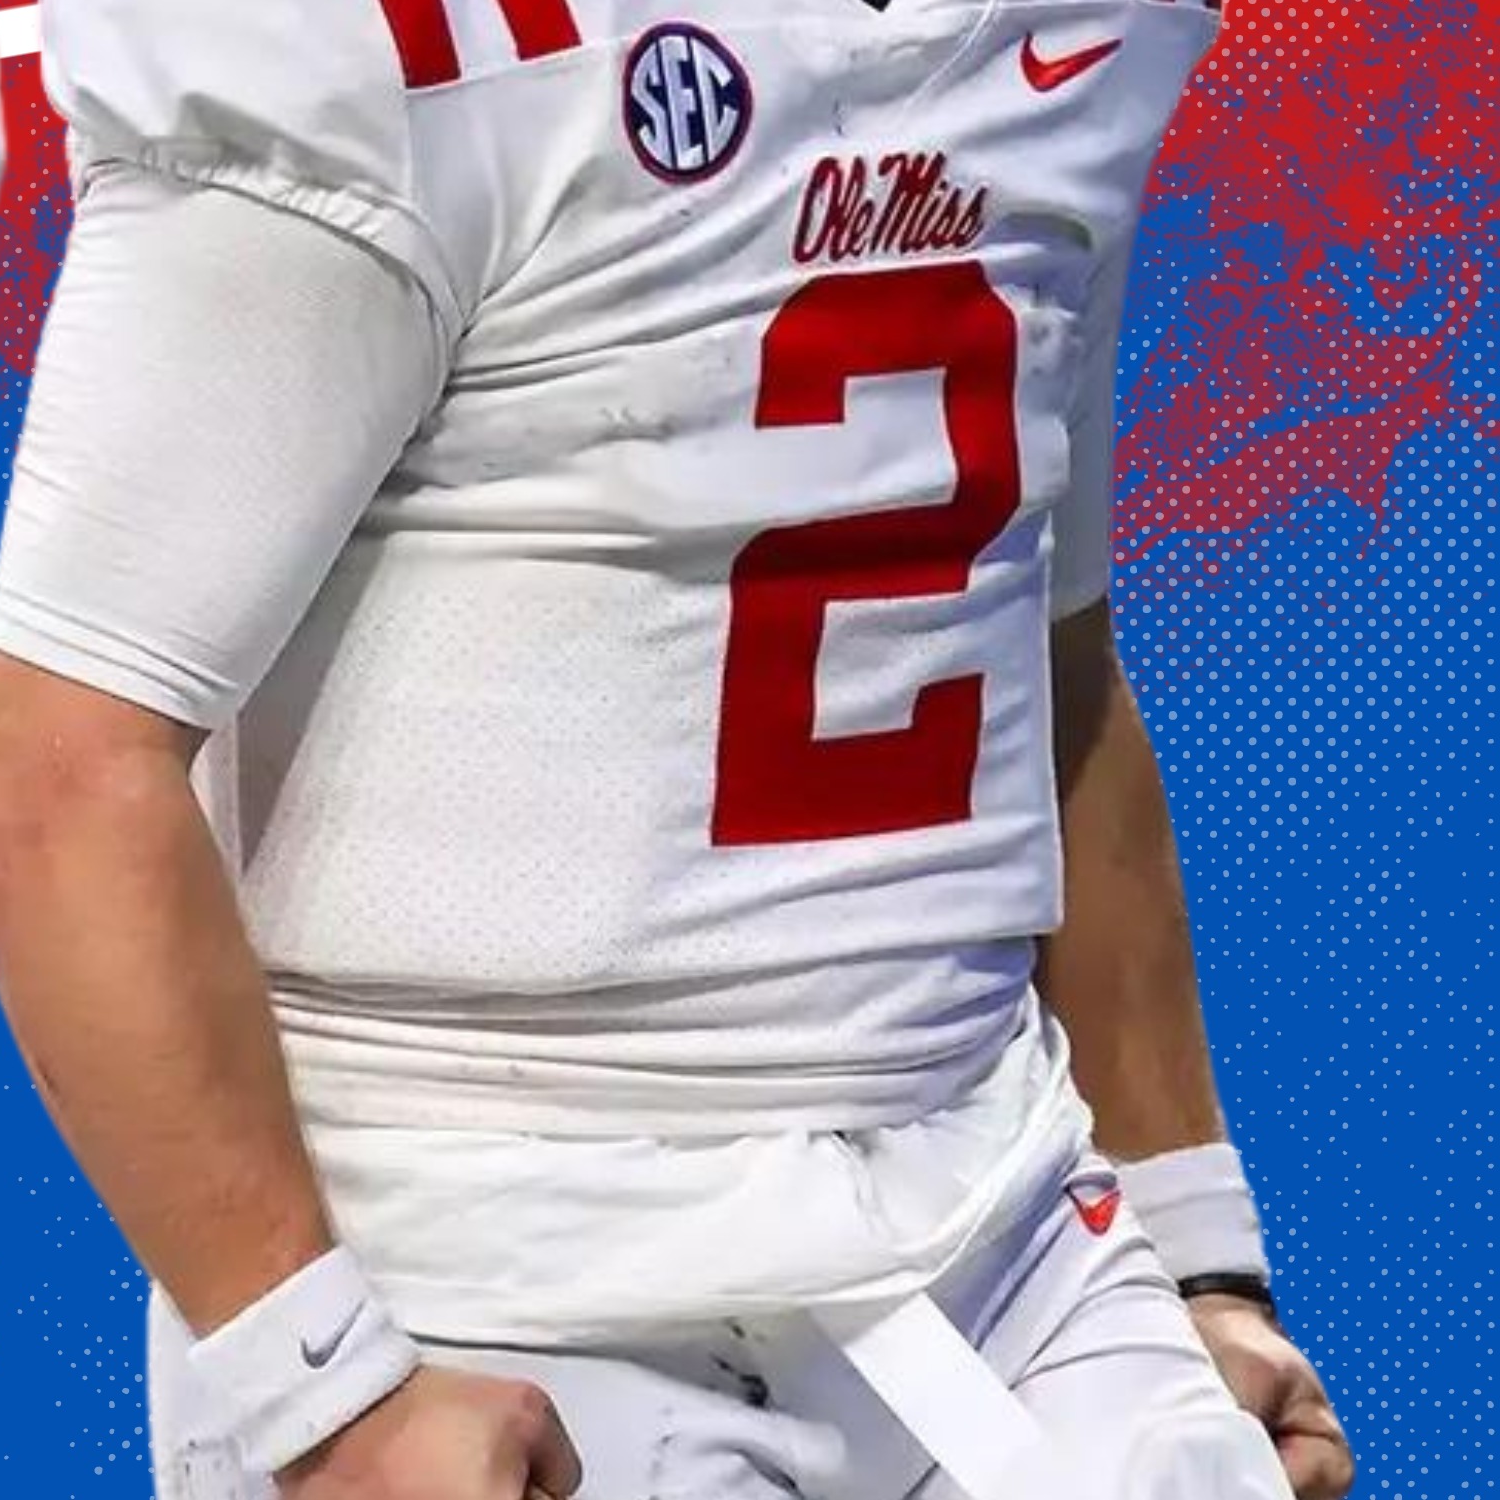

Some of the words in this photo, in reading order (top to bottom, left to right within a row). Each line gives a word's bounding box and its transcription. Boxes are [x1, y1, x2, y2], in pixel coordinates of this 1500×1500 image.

[631, 34, 740, 170] SEC
[793, 155, 876, 263] Ole
[868, 151, 989, 255] Miss
[711, 259, 1021, 846] 2
